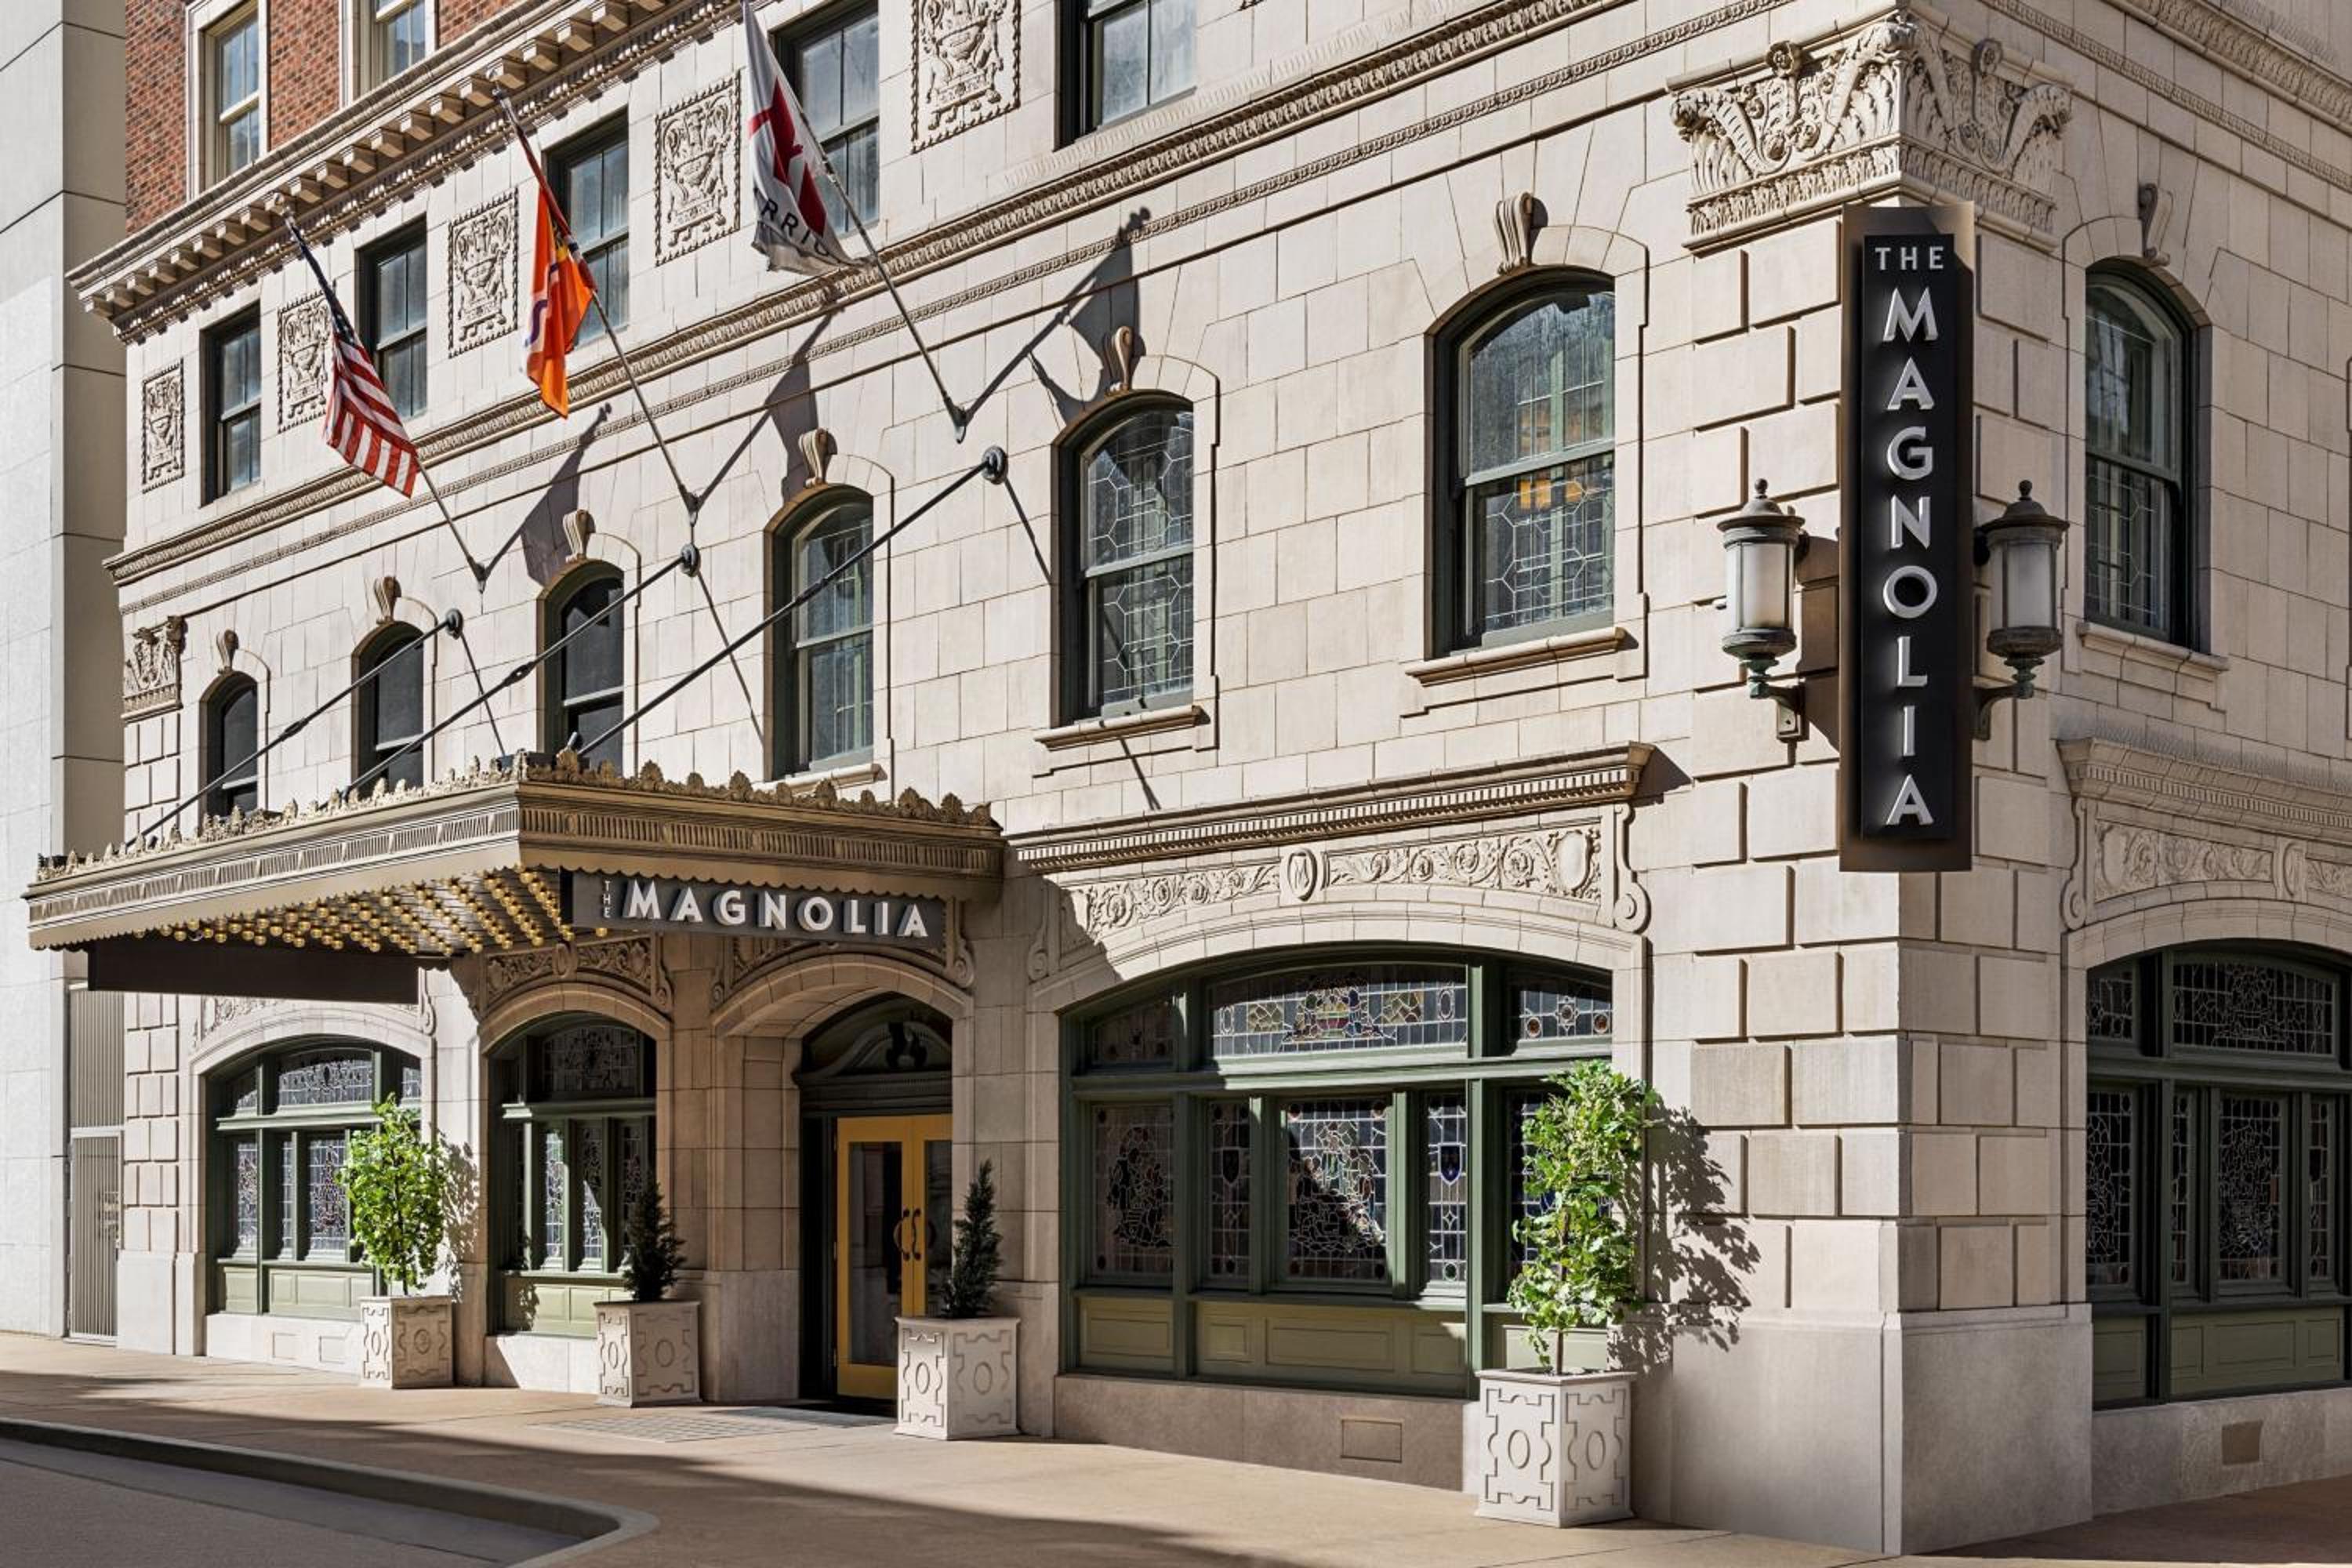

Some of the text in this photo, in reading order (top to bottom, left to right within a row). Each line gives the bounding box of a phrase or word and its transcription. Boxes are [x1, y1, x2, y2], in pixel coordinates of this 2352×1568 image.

[1875, 246, 1944, 270] THE
[1882, 286, 1939, 826] MAGNOLIA
[603, 879, 928, 938] THE MAGNOLIA
